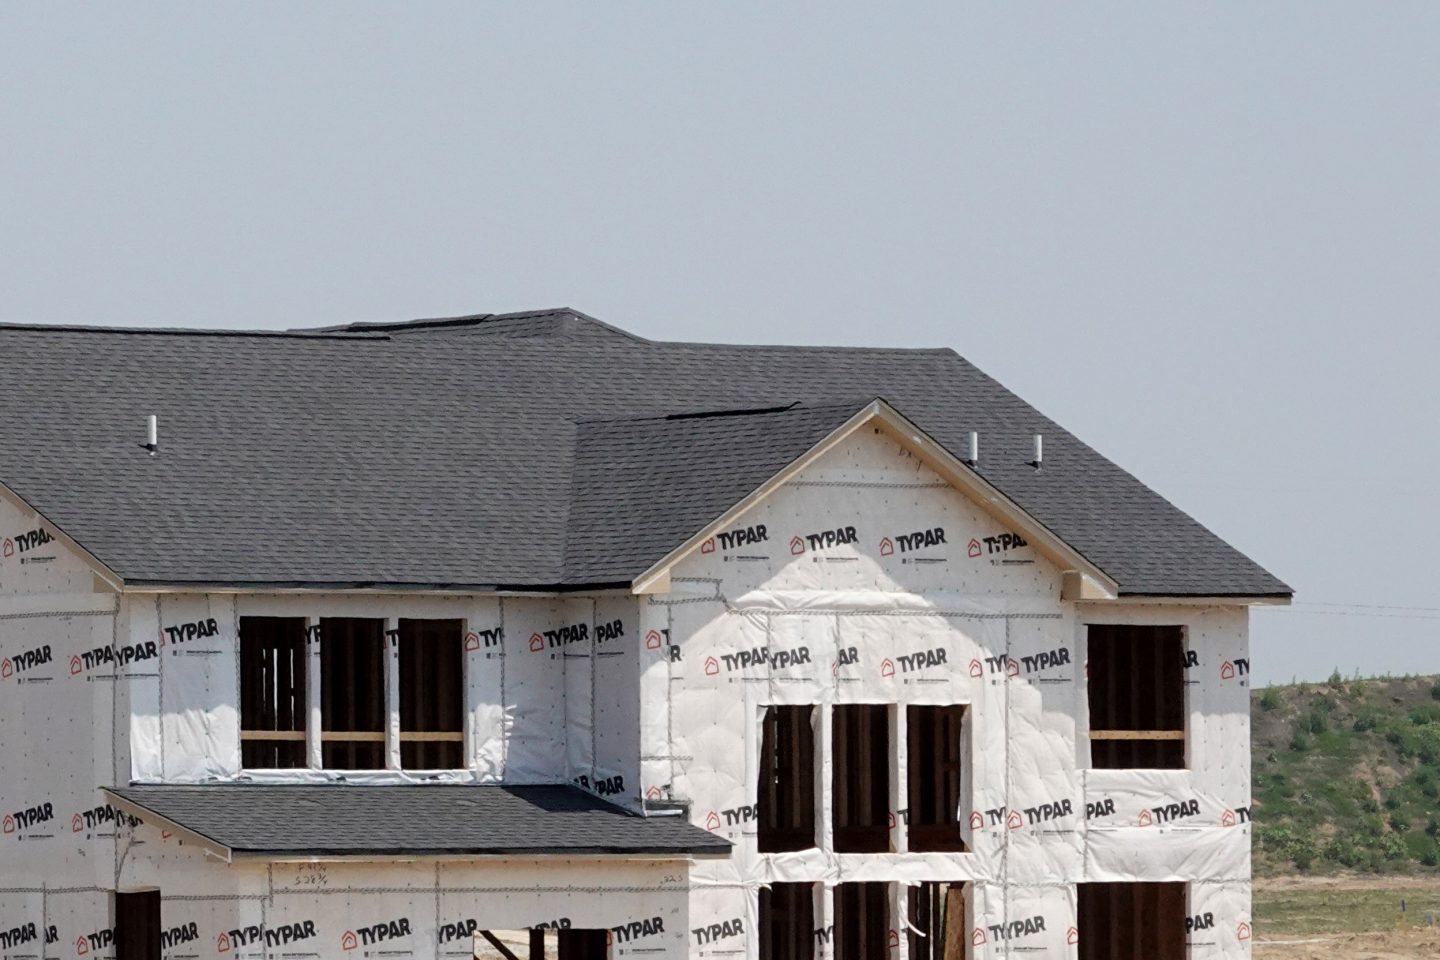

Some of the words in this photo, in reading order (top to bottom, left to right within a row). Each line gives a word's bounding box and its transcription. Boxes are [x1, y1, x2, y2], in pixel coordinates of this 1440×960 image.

[717, 524, 768, 550] TYPAR
[806, 526, 858, 551] TYPAR
[895, 527, 946, 553] TYPAR
[165, 618, 219, 644] TYPAR
[543, 623, 589, 648] TYPAR
[594, 619, 624, 643] PAR
[12, 645, 53, 673] TYPAR
[81, 645, 114, 670] TYPA
[115, 641, 158, 668] YPAR
[770, 646, 811, 670] YPAR
[897, 648, 947, 673] TYPAR
[1021, 648, 1071, 673] TYPAR
[13, 802, 53, 830] TYPAR
[83, 804, 114, 827] TYPA
[722, 803, 758, 826] TYPA
[1024, 799, 1073, 826] TYPAR
[1087, 799, 1115, 820] PAR
[1152, 800, 1200, 824] TYPAR
[357, 918, 412, 946] TYPAR
[612, 916, 665, 943] TYPAR
[691, 918, 745, 945] TYPAR
[1186, 912, 1214, 933] PAR
[0, 922, 37, 950] TYPAR
[229, 923, 263, 948] TYP
